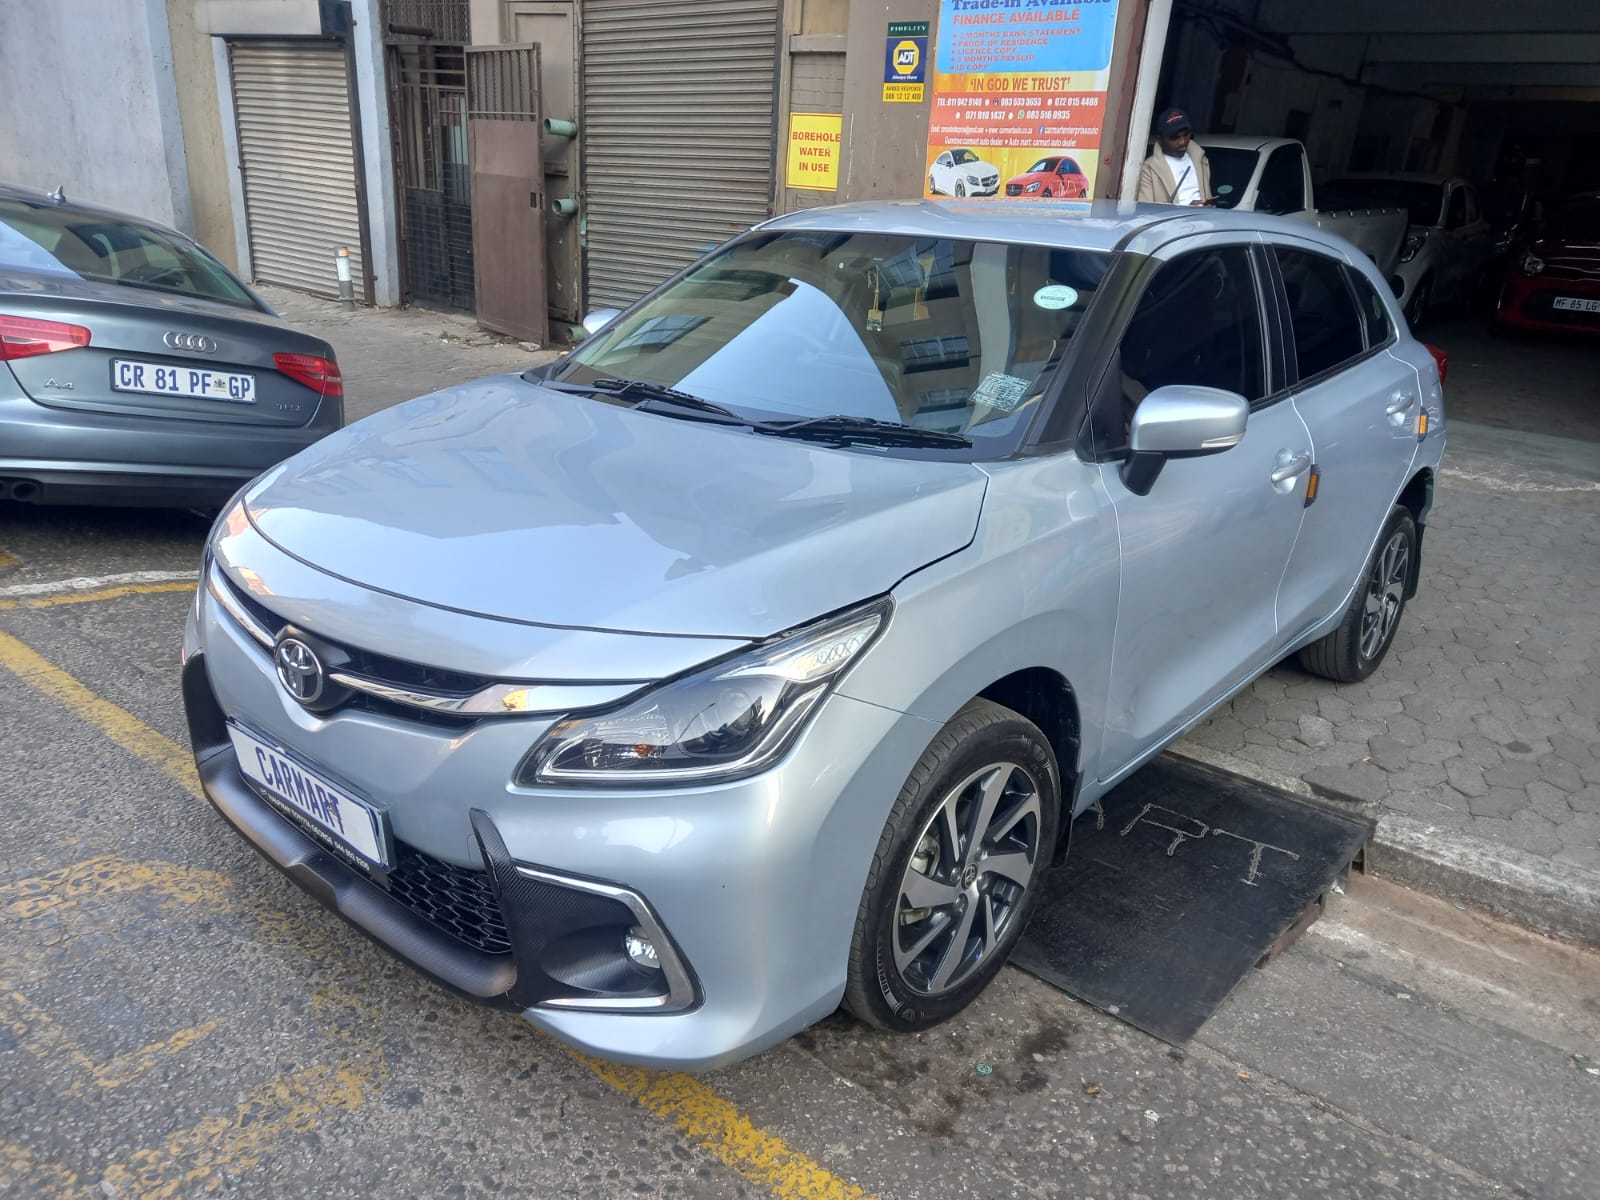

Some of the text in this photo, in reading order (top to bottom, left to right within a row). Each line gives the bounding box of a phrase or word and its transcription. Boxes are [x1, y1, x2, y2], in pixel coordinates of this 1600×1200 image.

[952, 0, 1021, 10] Trade-in
[953, 8, 1080, 25] FINANCE AVAILABLE
[1030, 28, 1081, 36] STATEMENT
[1001, 38, 1048, 46] RESIDENCE
[898, 51, 915, 63] ADT
[987, 78, 1009, 91] GOD
[1012, 77, 1028, 91] WE
[792, 131, 841, 142] BOREHOLE
[799, 147, 831, 157] WATER
[799, 162, 829, 172] IN USE
[44, 377, 74, 390] A4
[120, 364, 250, 399] CR 81 PF GP
[255, 746, 345, 835] CARMART
